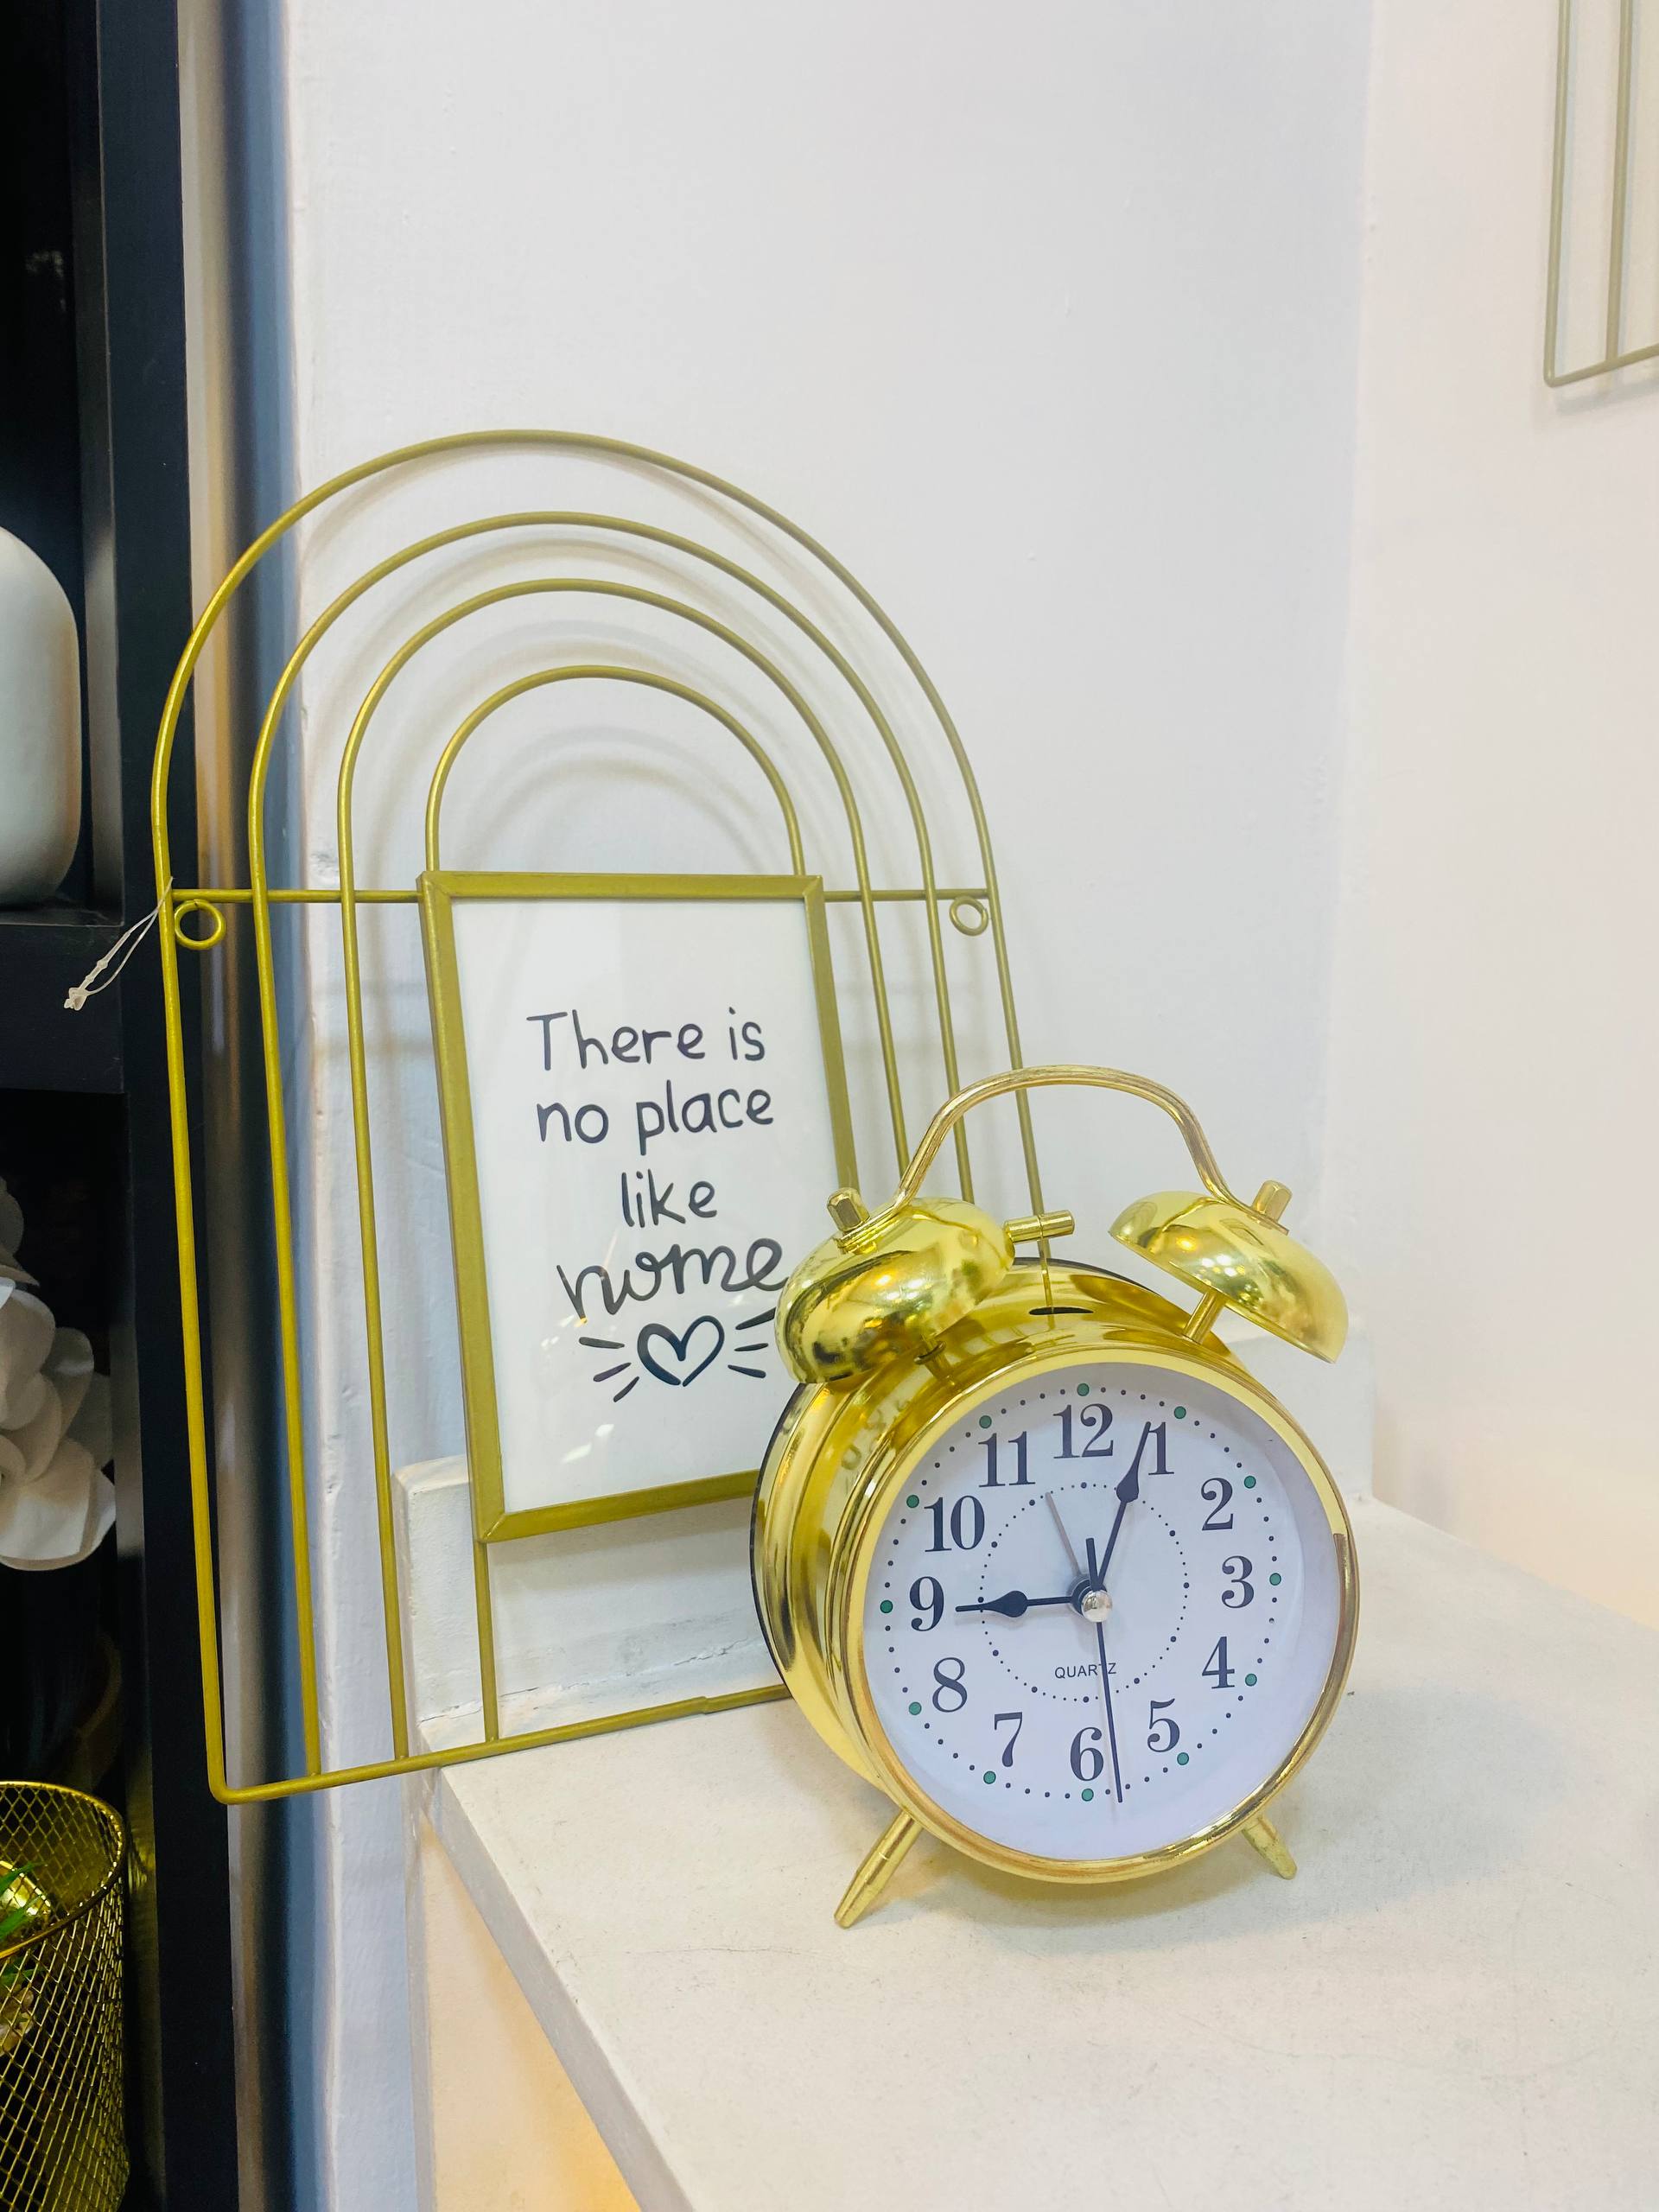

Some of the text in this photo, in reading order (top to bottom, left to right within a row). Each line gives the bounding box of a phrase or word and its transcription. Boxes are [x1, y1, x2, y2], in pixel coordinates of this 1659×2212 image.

[526, 1006, 766, 1071] There is
[536, 1079, 774, 1156] no place
[620, 1167, 718, 1229] like
[977, 1430, 1036, 1488] 11
[1052, 1402, 1115, 1459] 12
[1147, 1421, 1175, 1476] 1
[923, 1495, 986, 1553] 10
[1200, 1476, 1235, 1531] 2
[908, 1575, 945, 1632] 9
[1220, 1554, 1255, 1609] 3
[931, 1656, 969, 1713] 8
[1054, 1662, 1117, 1680] QUARZ
[1201, 1635, 1236, 1690] 4
[993, 1711, 1024, 1769] 7
[1146, 1697, 1181, 1754] 5
[1069, 1726, 1105, 1783] 6
